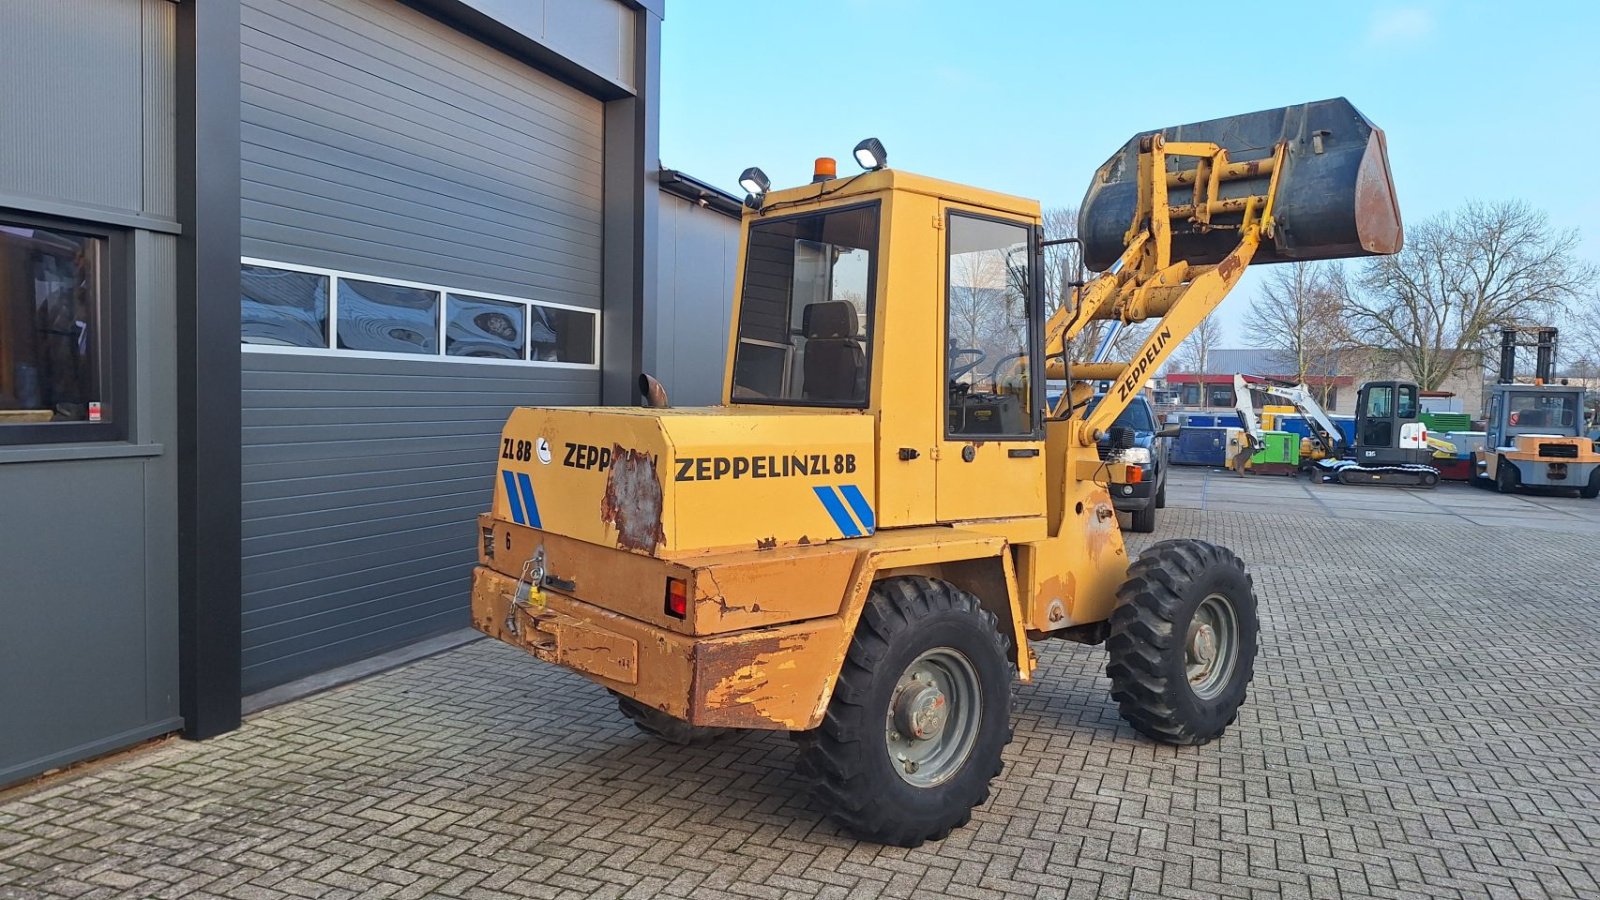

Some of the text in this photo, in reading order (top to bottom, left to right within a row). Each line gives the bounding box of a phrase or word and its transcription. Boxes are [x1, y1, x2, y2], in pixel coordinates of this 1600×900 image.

[1117, 326, 1171, 402] ZEPPELIN
[502, 438, 514, 459] ZL
[516, 440, 532, 461] 8B
[563, 442, 658, 472] ZEPP
[675, 455, 808, 481] ZEPPELIN
[834, 454, 856, 474] 8B
[505, 531, 511, 550] 6
